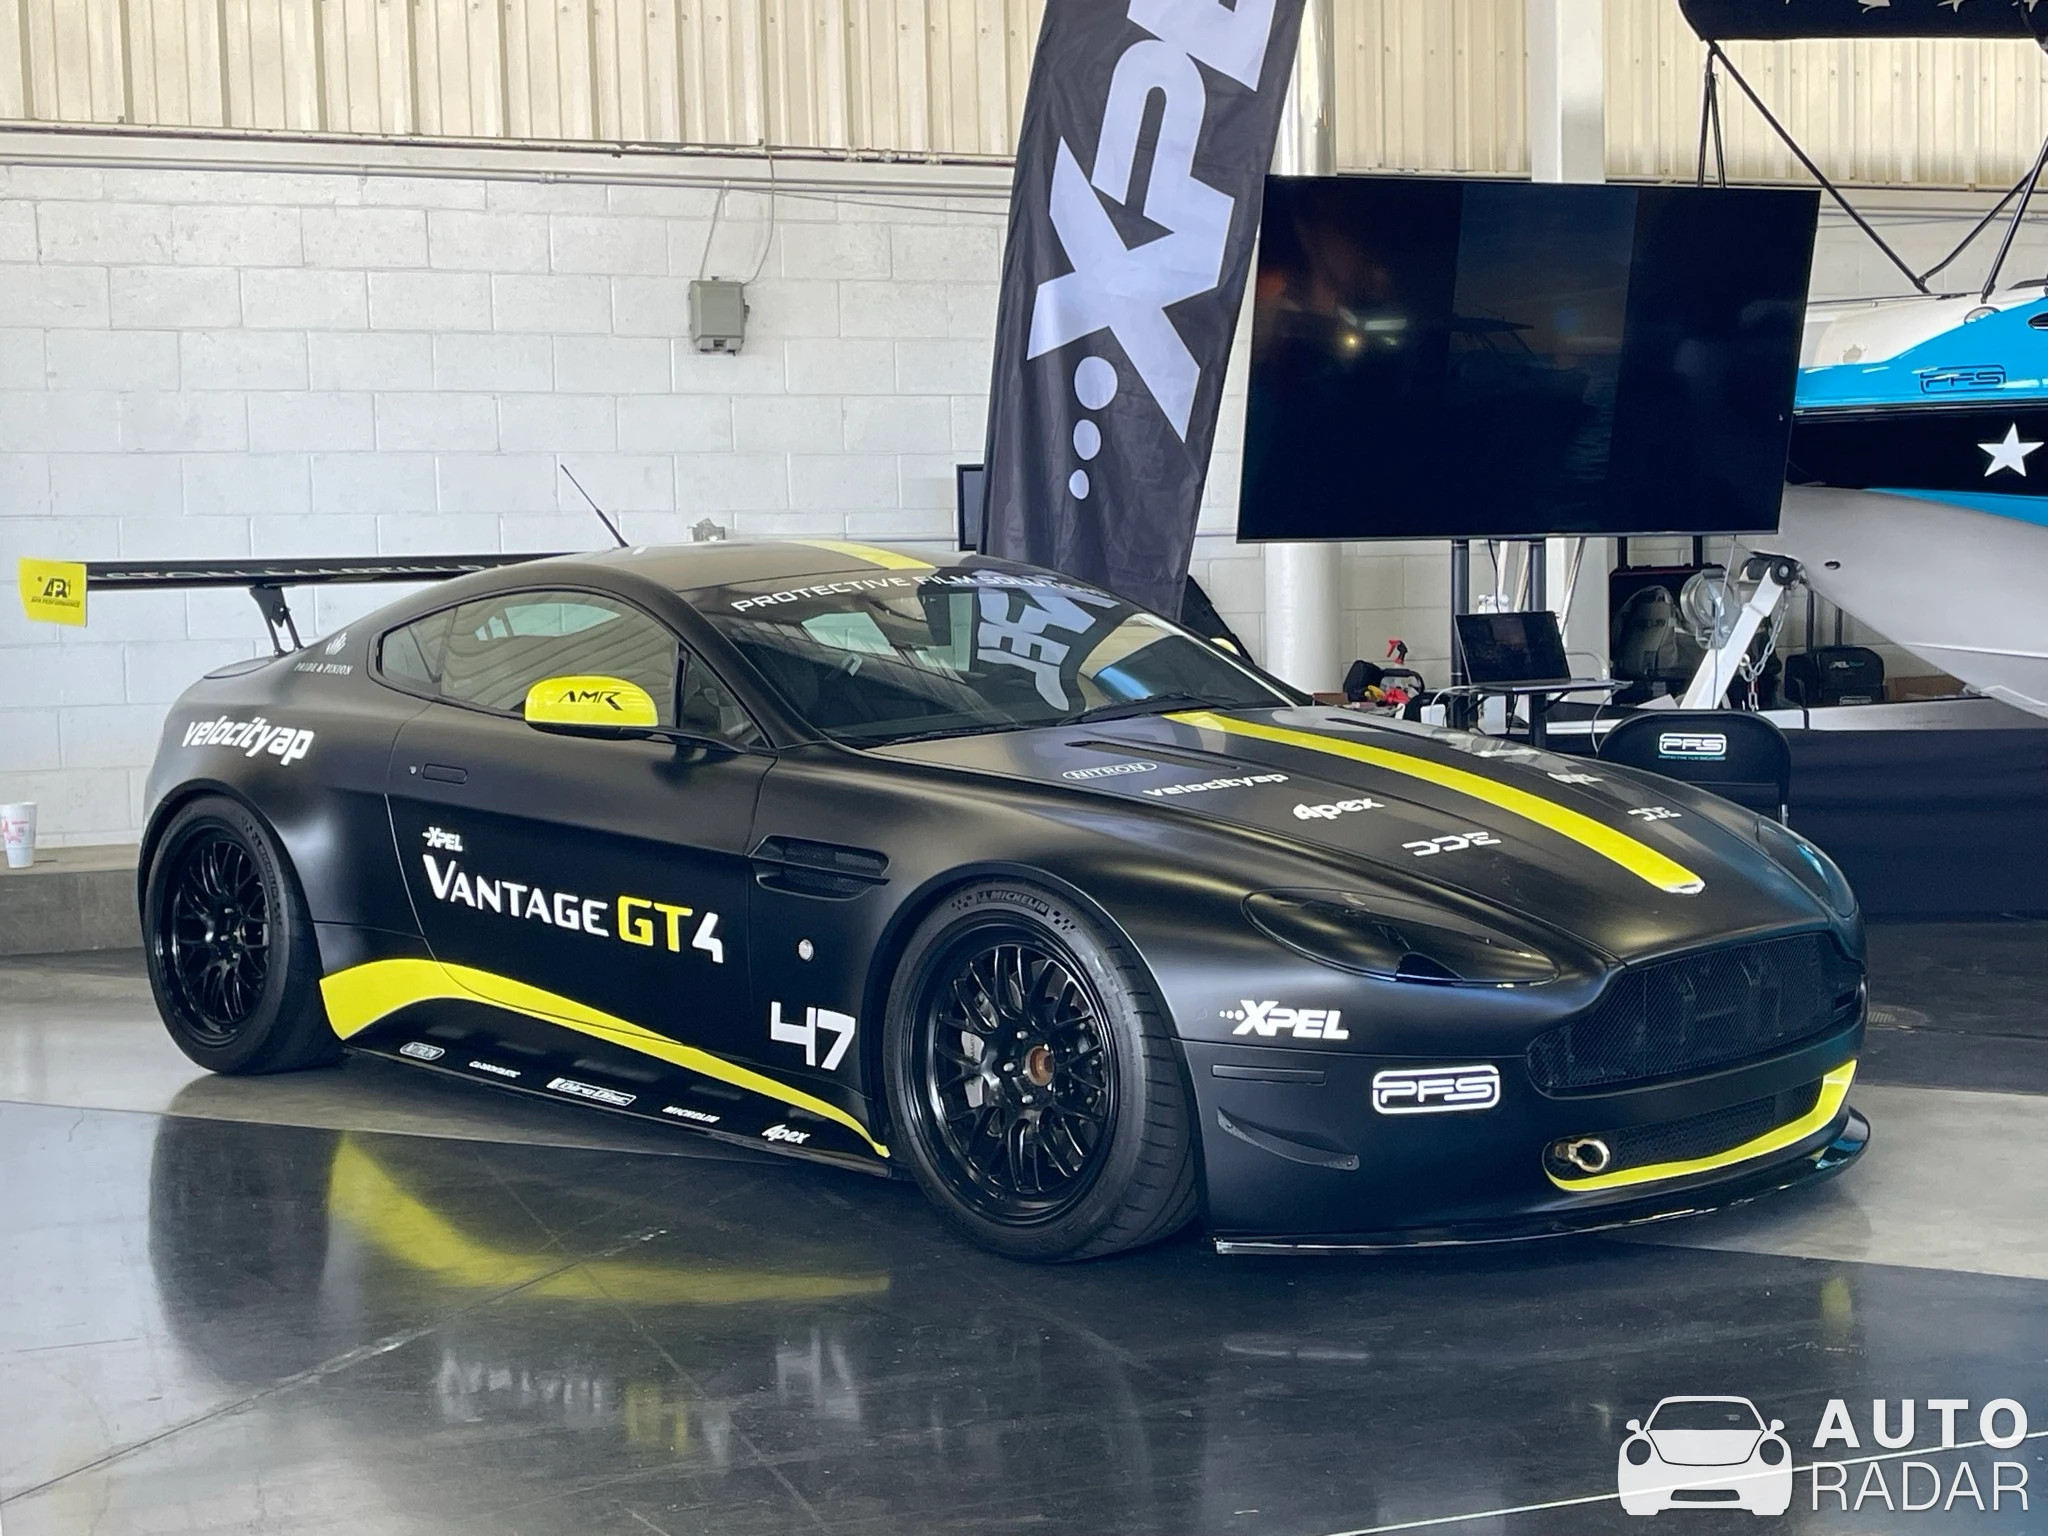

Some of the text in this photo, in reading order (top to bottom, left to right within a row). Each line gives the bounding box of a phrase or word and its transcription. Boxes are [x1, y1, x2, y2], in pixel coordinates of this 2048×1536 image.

[731, 577, 911, 613] PROTECTIVE
[912, 573, 975, 586] FILM
[558, 690, 623, 711] AMR
[182, 715, 314, 766] velocityap
[1659, 734, 1727, 754] PFS
[1068, 763, 1154, 779] NITRON
[1143, 773, 1289, 796] velocityap
[1292, 798, 1385, 820] Apex
[426, 826, 463, 851] XPEL
[990, 890, 1050, 915] MICHELIN
[618, 895, 724, 964] GT4
[1232, 999, 1349, 1040] XPEL
[771, 1002, 856, 1071] 47
[1373, 1067, 1500, 1112] PFS
[662, 1105, 720, 1123] MICHELIN
[761, 1124, 811, 1144] Apex
